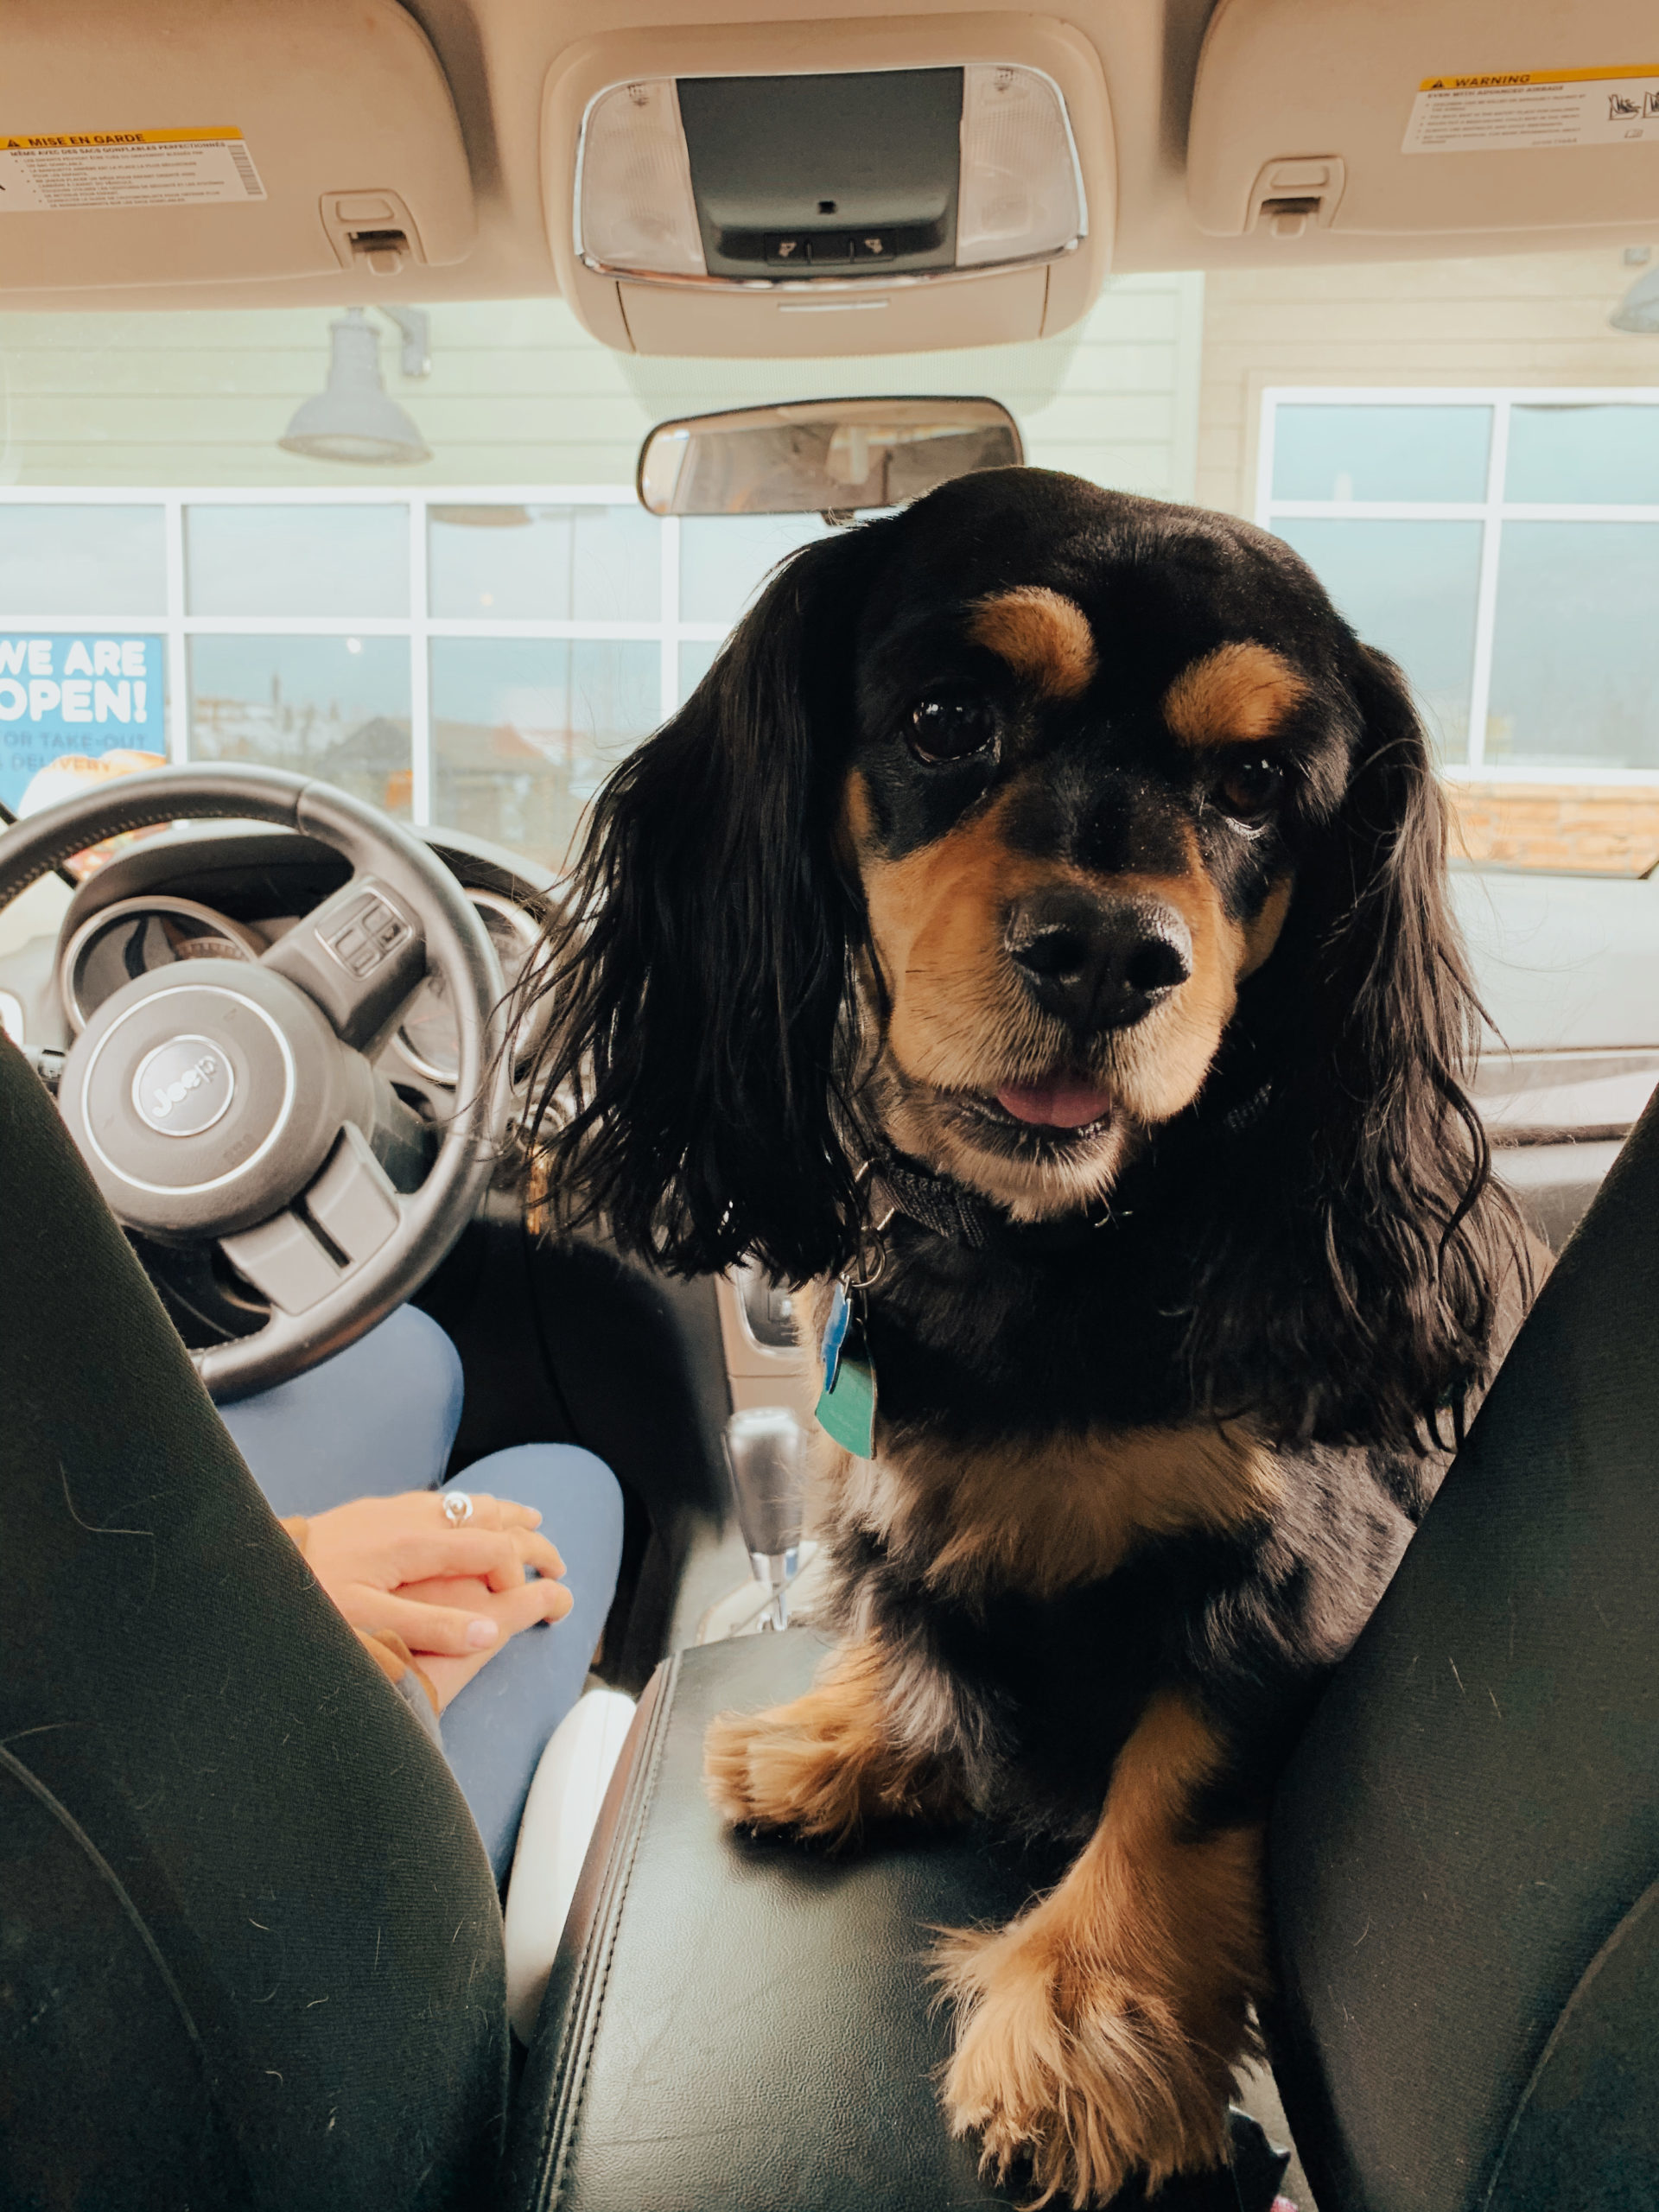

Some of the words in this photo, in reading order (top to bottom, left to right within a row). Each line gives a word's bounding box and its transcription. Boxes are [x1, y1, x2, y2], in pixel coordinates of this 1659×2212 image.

[1454, 74, 1531, 87] WARNING
[28, 137, 66, 147] MISE
[69, 136, 91, 145] EN
[93, 133, 145, 144] GARDE
[0, 639, 53, 676] WE
[64, 640, 147, 676] ARE
[0, 677, 147, 723] OPEN!
[0, 730, 33, 747] OR
[40, 731, 147, 750] TAKE-OUT
[152, 1056, 215, 1117] Jeep
